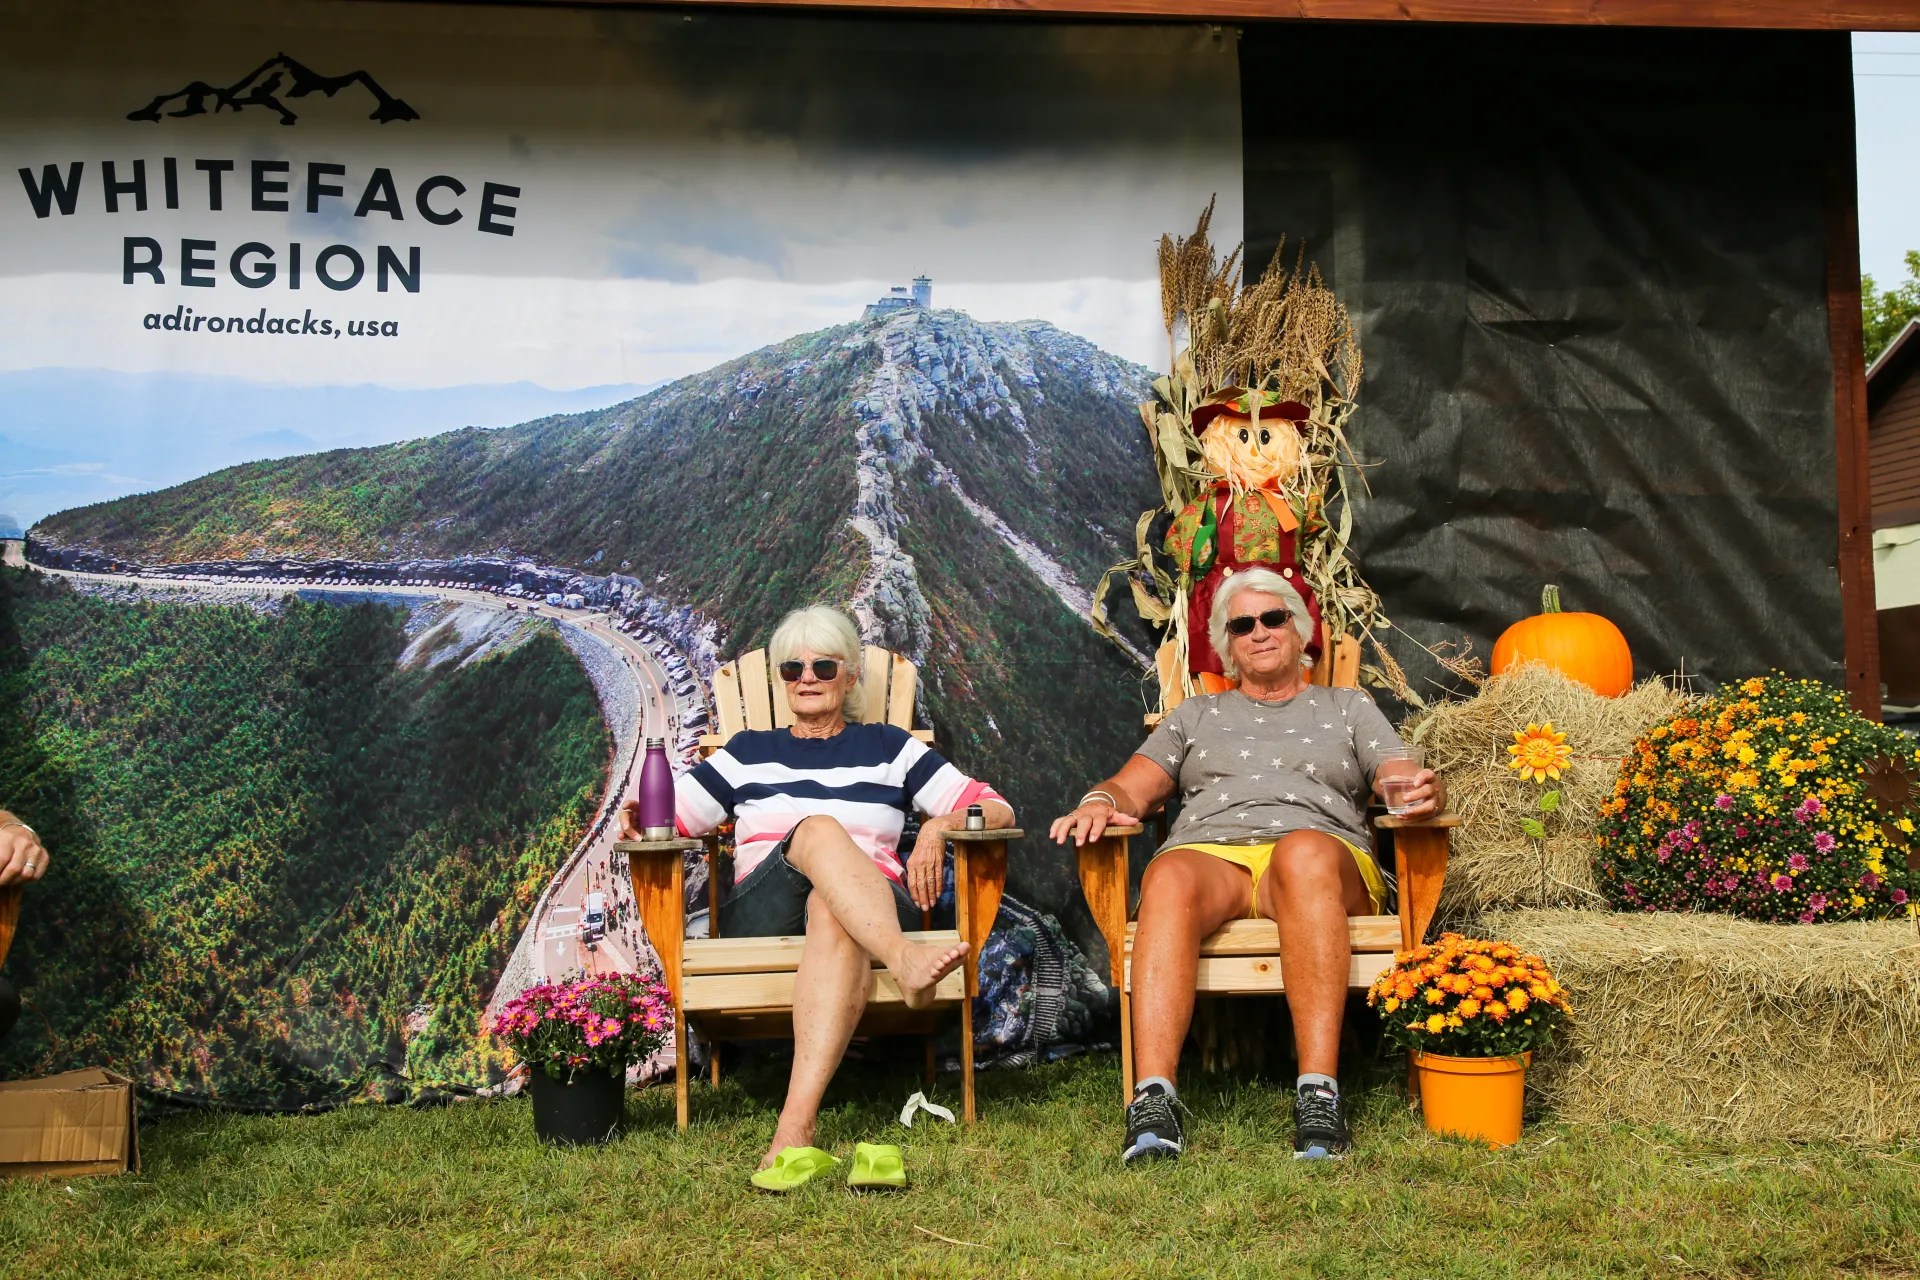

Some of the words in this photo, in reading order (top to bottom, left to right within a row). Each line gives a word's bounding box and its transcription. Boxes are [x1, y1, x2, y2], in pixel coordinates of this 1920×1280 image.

[18, 157, 521, 237] WHITEFACE
[123, 236, 421, 293] REGION
[143, 305, 342, 340] adirondacks,
[347, 320, 399, 337] usa
